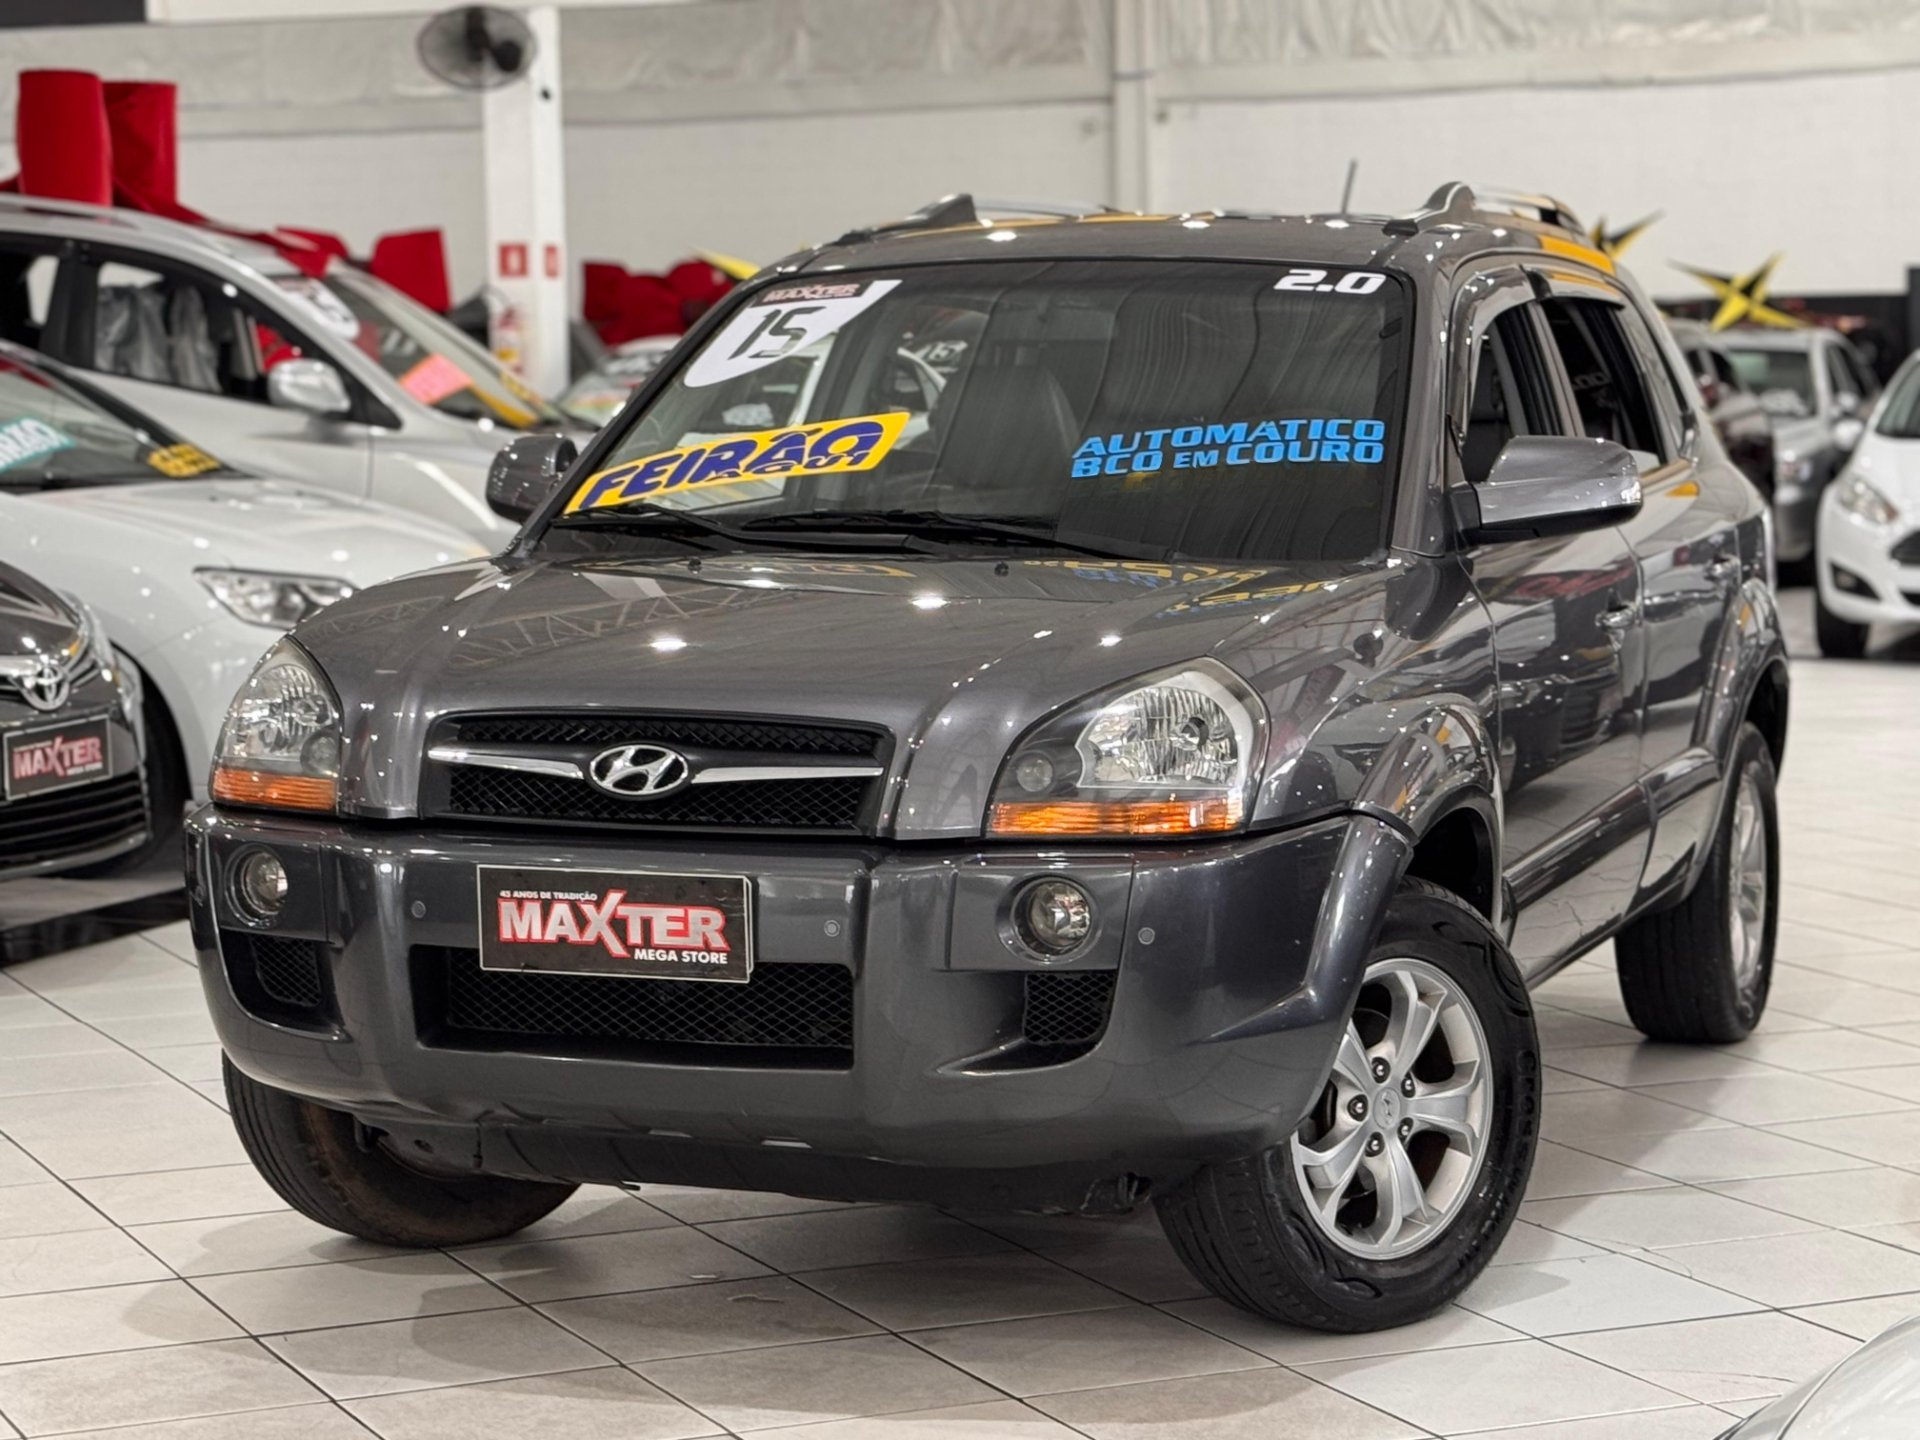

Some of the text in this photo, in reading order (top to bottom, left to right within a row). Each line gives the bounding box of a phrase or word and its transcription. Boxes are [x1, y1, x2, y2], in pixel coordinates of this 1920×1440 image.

[1273, 269, 1387, 294] 2.0
[727, 306, 828, 360] 15
[578, 420, 885, 509] FEIRÃO
[1071, 441, 1385, 478] BCO EM COURO
[13, 735, 103, 779] MAXTER
[540, 891, 552, 899] DE
[497, 889, 731, 958] MAXTER
[634, 949, 728, 965] MEGA STORE
